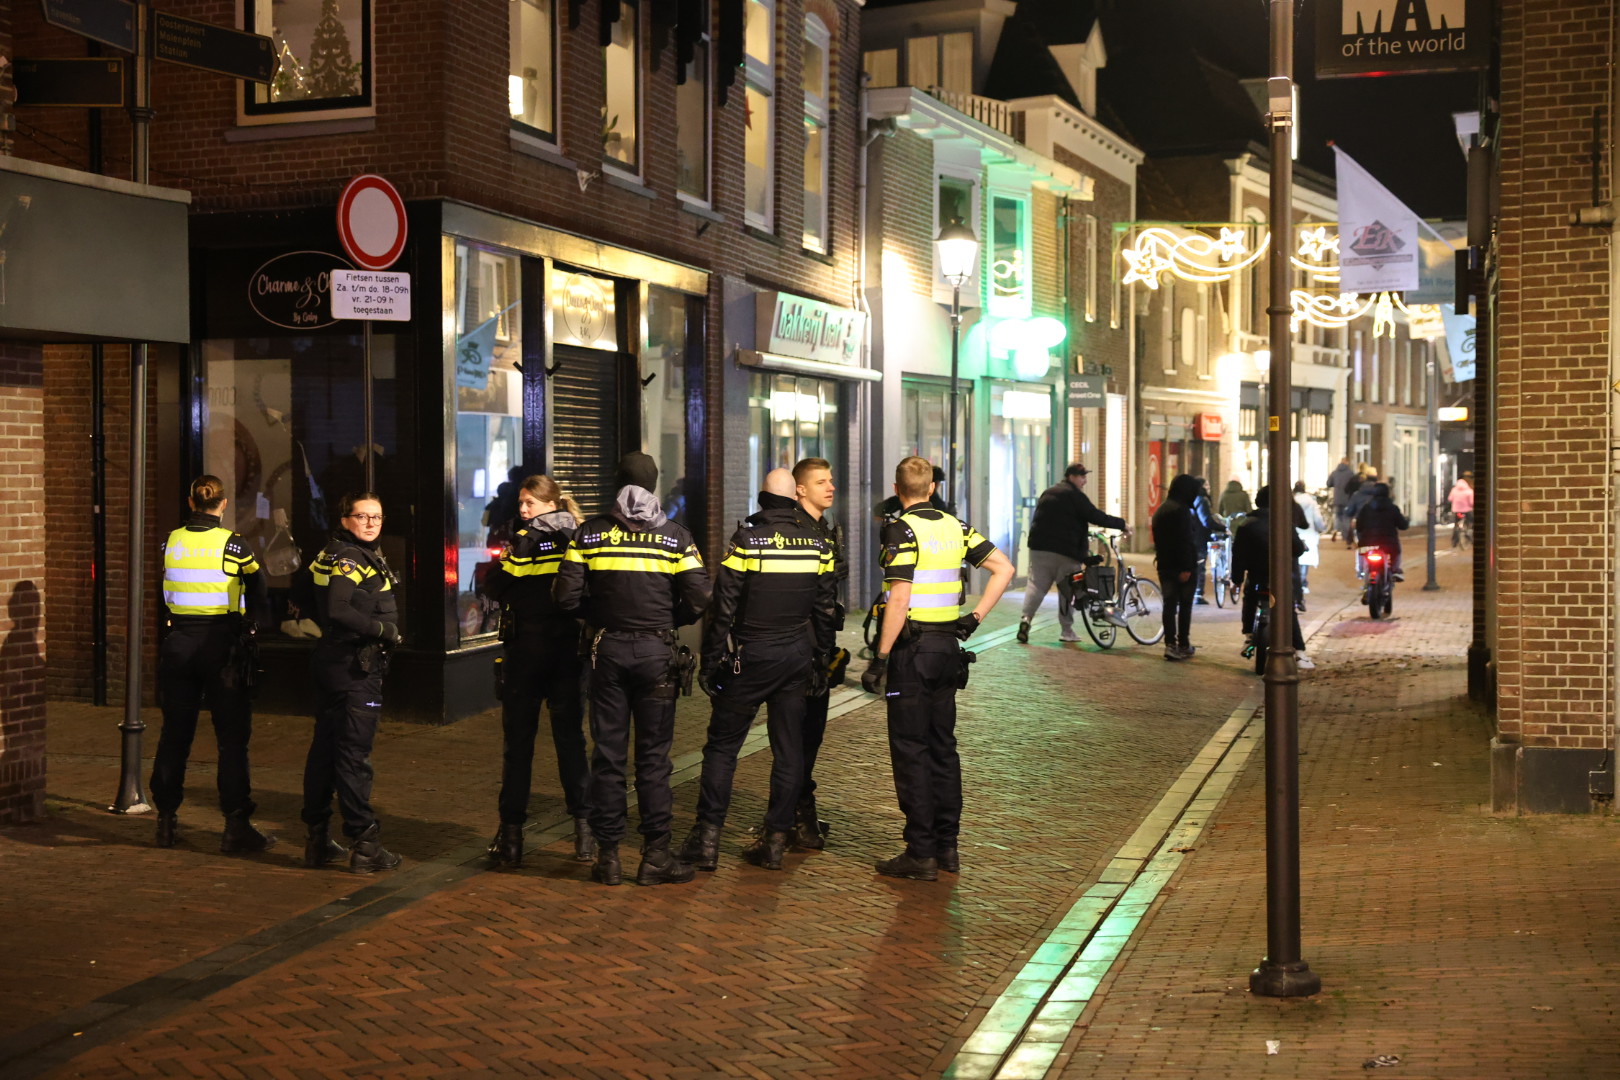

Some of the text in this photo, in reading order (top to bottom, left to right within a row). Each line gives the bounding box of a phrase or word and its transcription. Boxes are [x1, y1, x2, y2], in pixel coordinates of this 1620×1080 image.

[159, 17, 205, 36] Oosterpoort
[1341, 0, 1466, 35] MAN
[159, 30, 202, 48] Molenplein
[1342, 32, 1466, 57] of the world
[159, 43, 188, 58] Station
[257, 273, 300, 296] Charme
[346, 273, 400, 284] Fietsen tussen
[336, 284, 348, 292] Za.
[351, 284, 367, 293] t/m
[368, 285, 379, 293] do.
[364, 296, 387, 304] 21-09
[389, 296, 394, 304] h
[353, 306, 393, 316] toegestaan
[775, 300, 822, 352] bakkerij
[601, 526, 663, 545] POLITIE
[767, 532, 814, 549] POLITIE
